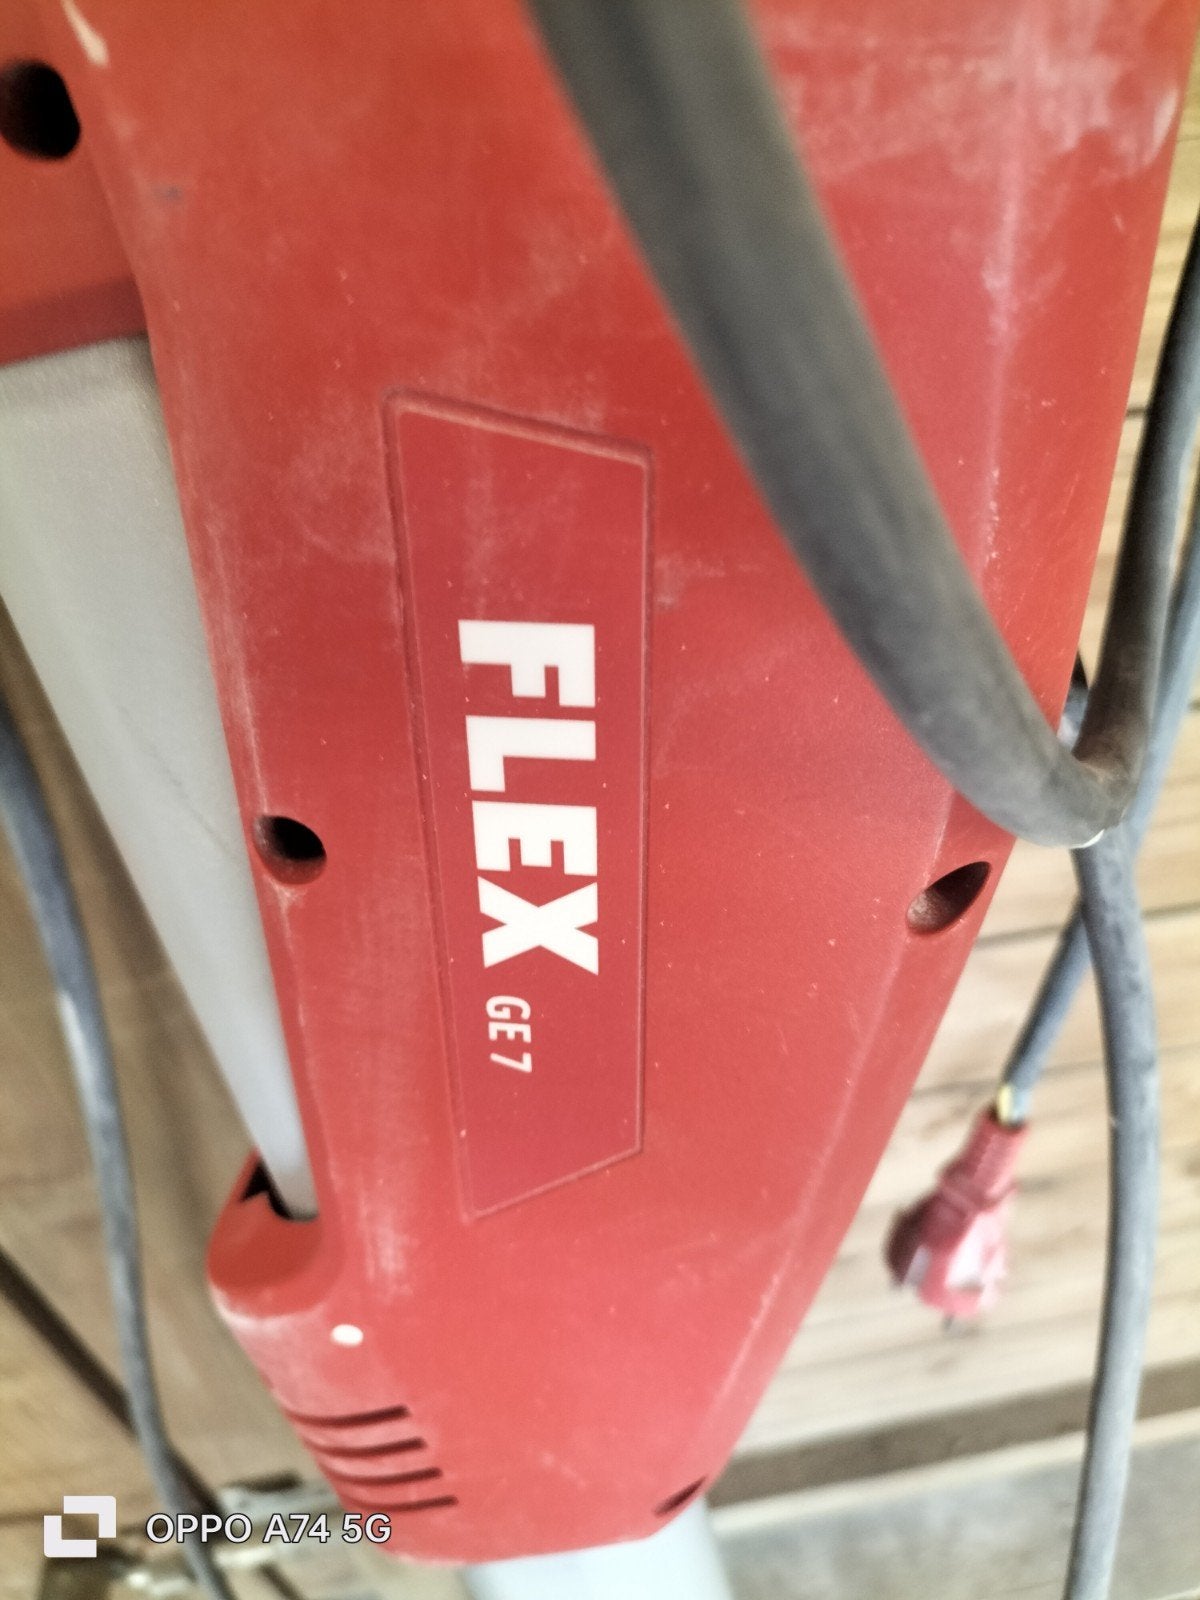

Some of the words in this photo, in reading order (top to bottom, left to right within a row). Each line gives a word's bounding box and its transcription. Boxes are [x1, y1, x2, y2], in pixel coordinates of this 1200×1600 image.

[458, 619, 599, 976] FLEX
[485, 995, 532, 1044] GE
[489, 1052, 533, 1074] 7
